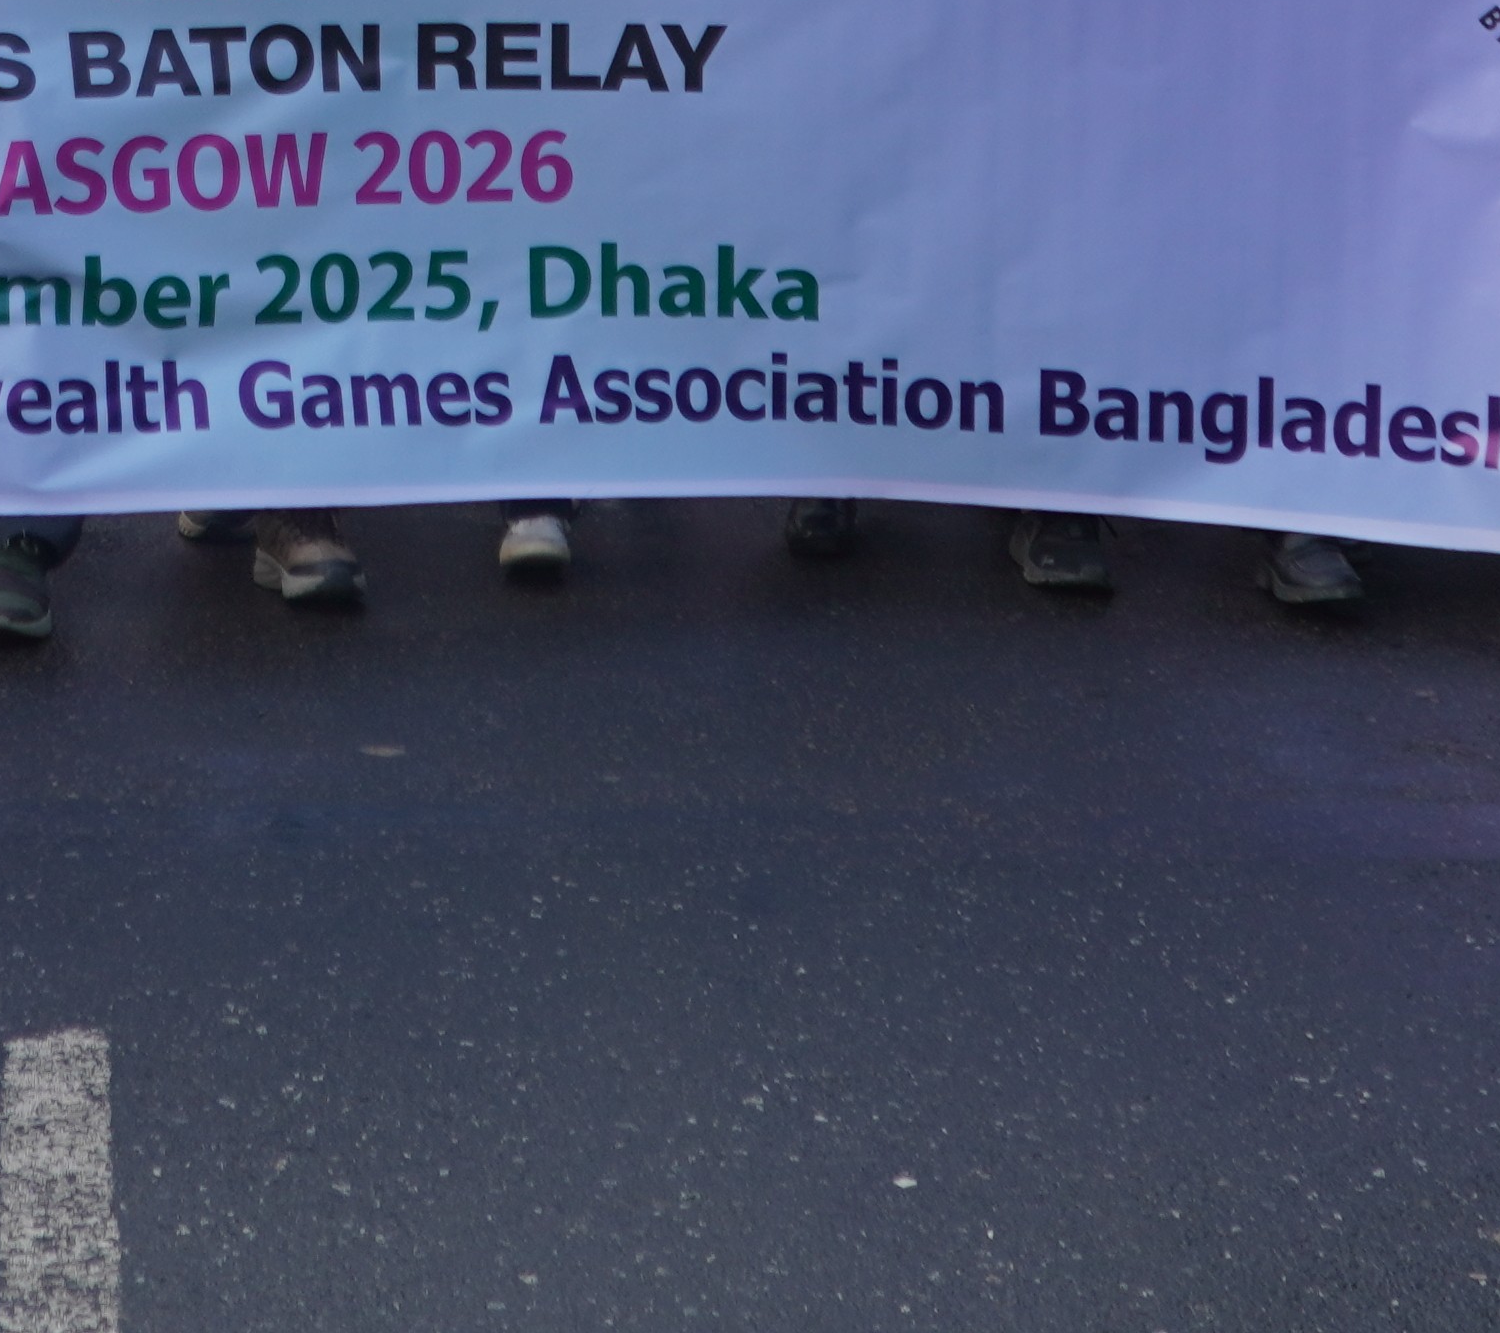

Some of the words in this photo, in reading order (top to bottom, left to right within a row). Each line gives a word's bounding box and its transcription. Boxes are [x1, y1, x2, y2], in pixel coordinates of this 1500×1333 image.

[68, 23, 381, 98] BATON
[417, 21, 728, 93] RELAY
[353, 129, 575, 206] 2026
[255, 249, 500, 332] 2025,
[528, 241, 820, 322] Dhaka
[238, 360, 511, 432] Games
[539, 352, 1005, 434] Association
